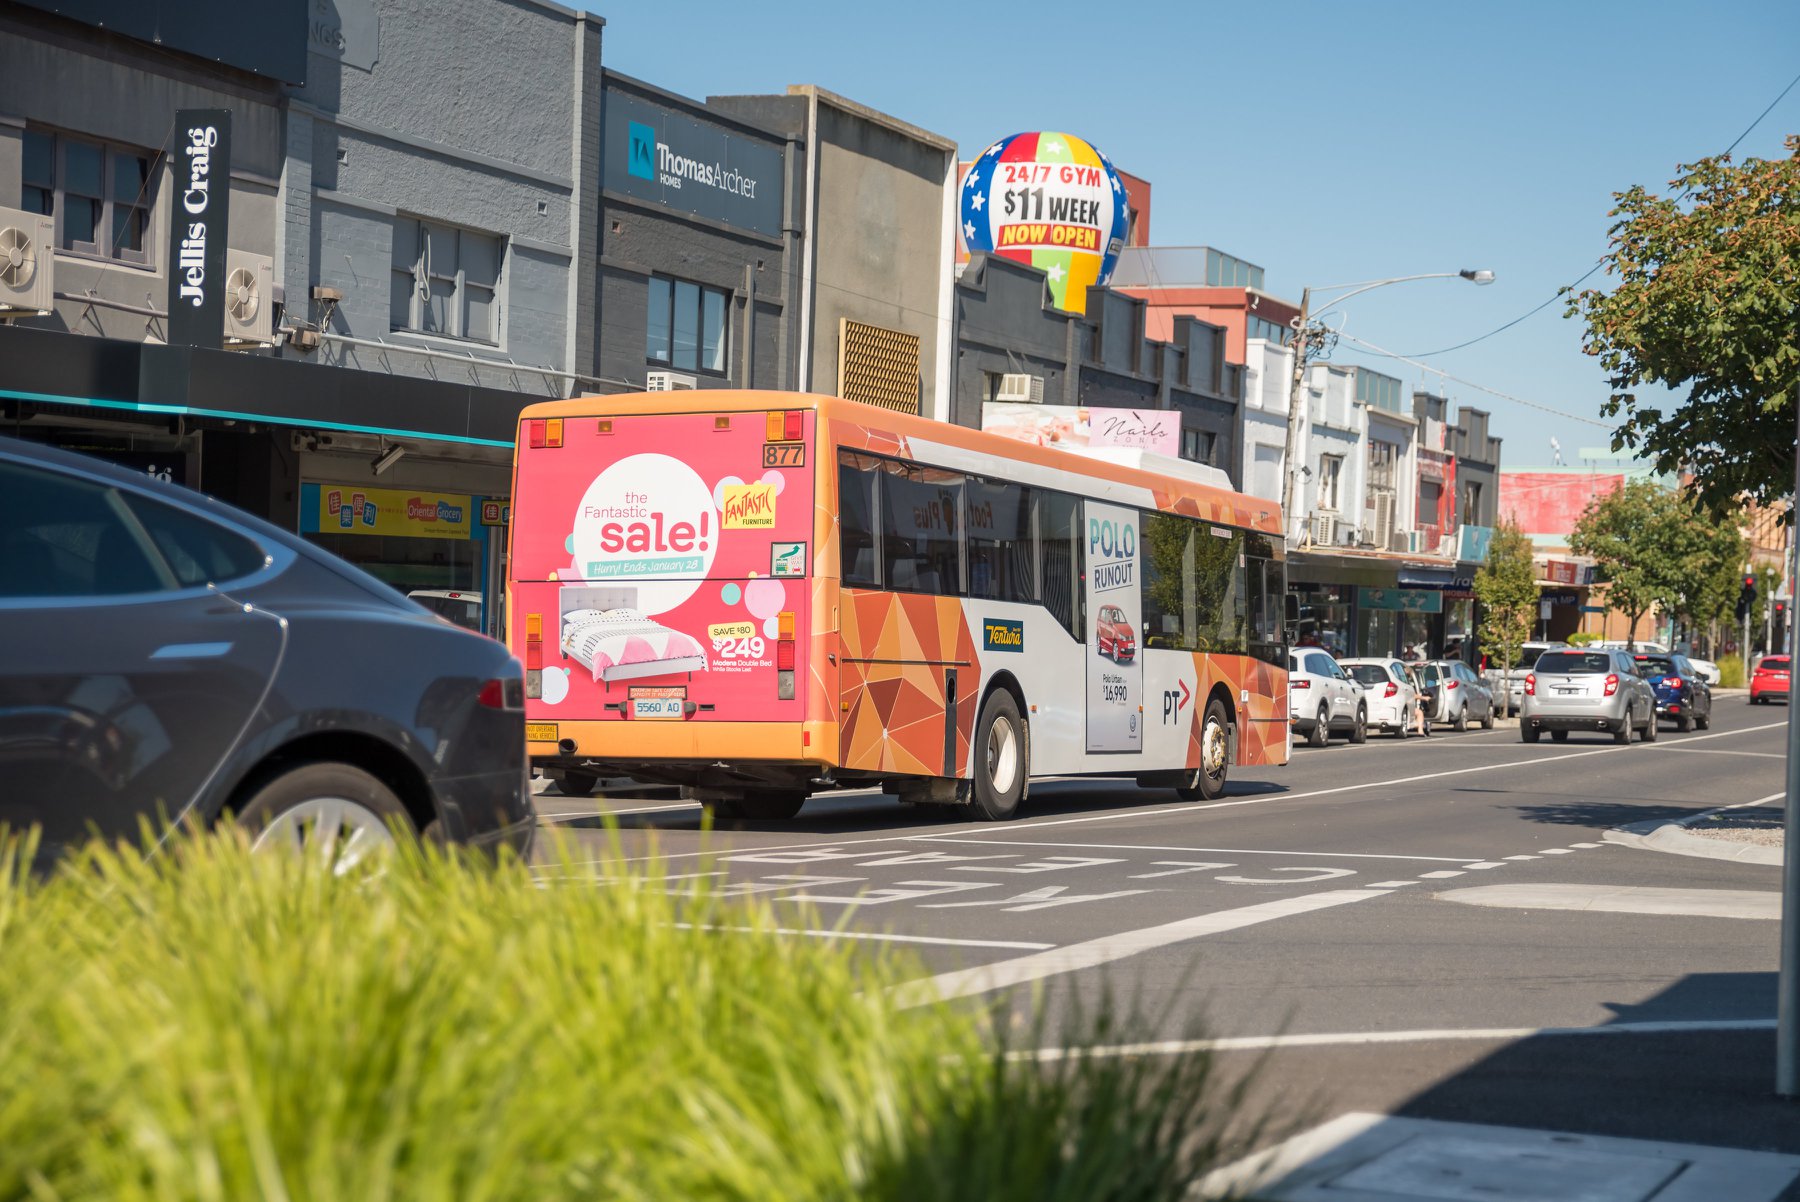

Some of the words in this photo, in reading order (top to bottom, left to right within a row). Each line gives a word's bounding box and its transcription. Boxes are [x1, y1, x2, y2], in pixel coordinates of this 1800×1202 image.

[184, 126, 217, 214] Craig
[657, 142, 757, 199] ThomasArcher
[1004, 165, 1052, 184] 24/7
[1060, 165, 1101, 188] GYM
[660, 173, 682, 190] HOMES
[1004, 187, 1044, 221] $11
[1049, 196, 1101, 226] WEEK
[1002, 225, 1048, 246] NOW
[1052, 225, 1097, 249] OPEN
[179, 222, 207, 307] Jellis
[1103, 416, 1169, 438] Nails
[1113, 435, 1159, 445] ZONE
[765, 445, 803, 466] 877
[625, 491, 648, 504] the
[725, 487, 772, 526] FANTASTIC
[408, 504, 436, 518] Oriental
[436, 506, 462, 522] Grocery
[584, 505, 647, 518] Fantastic
[742, 518, 773, 526] FURNITURE
[600, 511, 710, 554] sale!
[1089, 518, 1135, 558] POLO
[593, 563, 622, 576] Hurry!
[623, 562, 647, 574] Ends
[648, 560, 684, 573] January
[686, 559, 699, 571] 28
[1094, 563, 1133, 590] RUNOUT
[713, 627, 736, 636] SAVE
[737, 626, 751, 635] $80
[985, 625, 1022, 646] Ventura
[712, 636, 765, 658] $249
[1102, 685, 1128, 704] $16,990
[637, 702, 662, 712] 5560
[1163, 690, 1180, 725] PT
